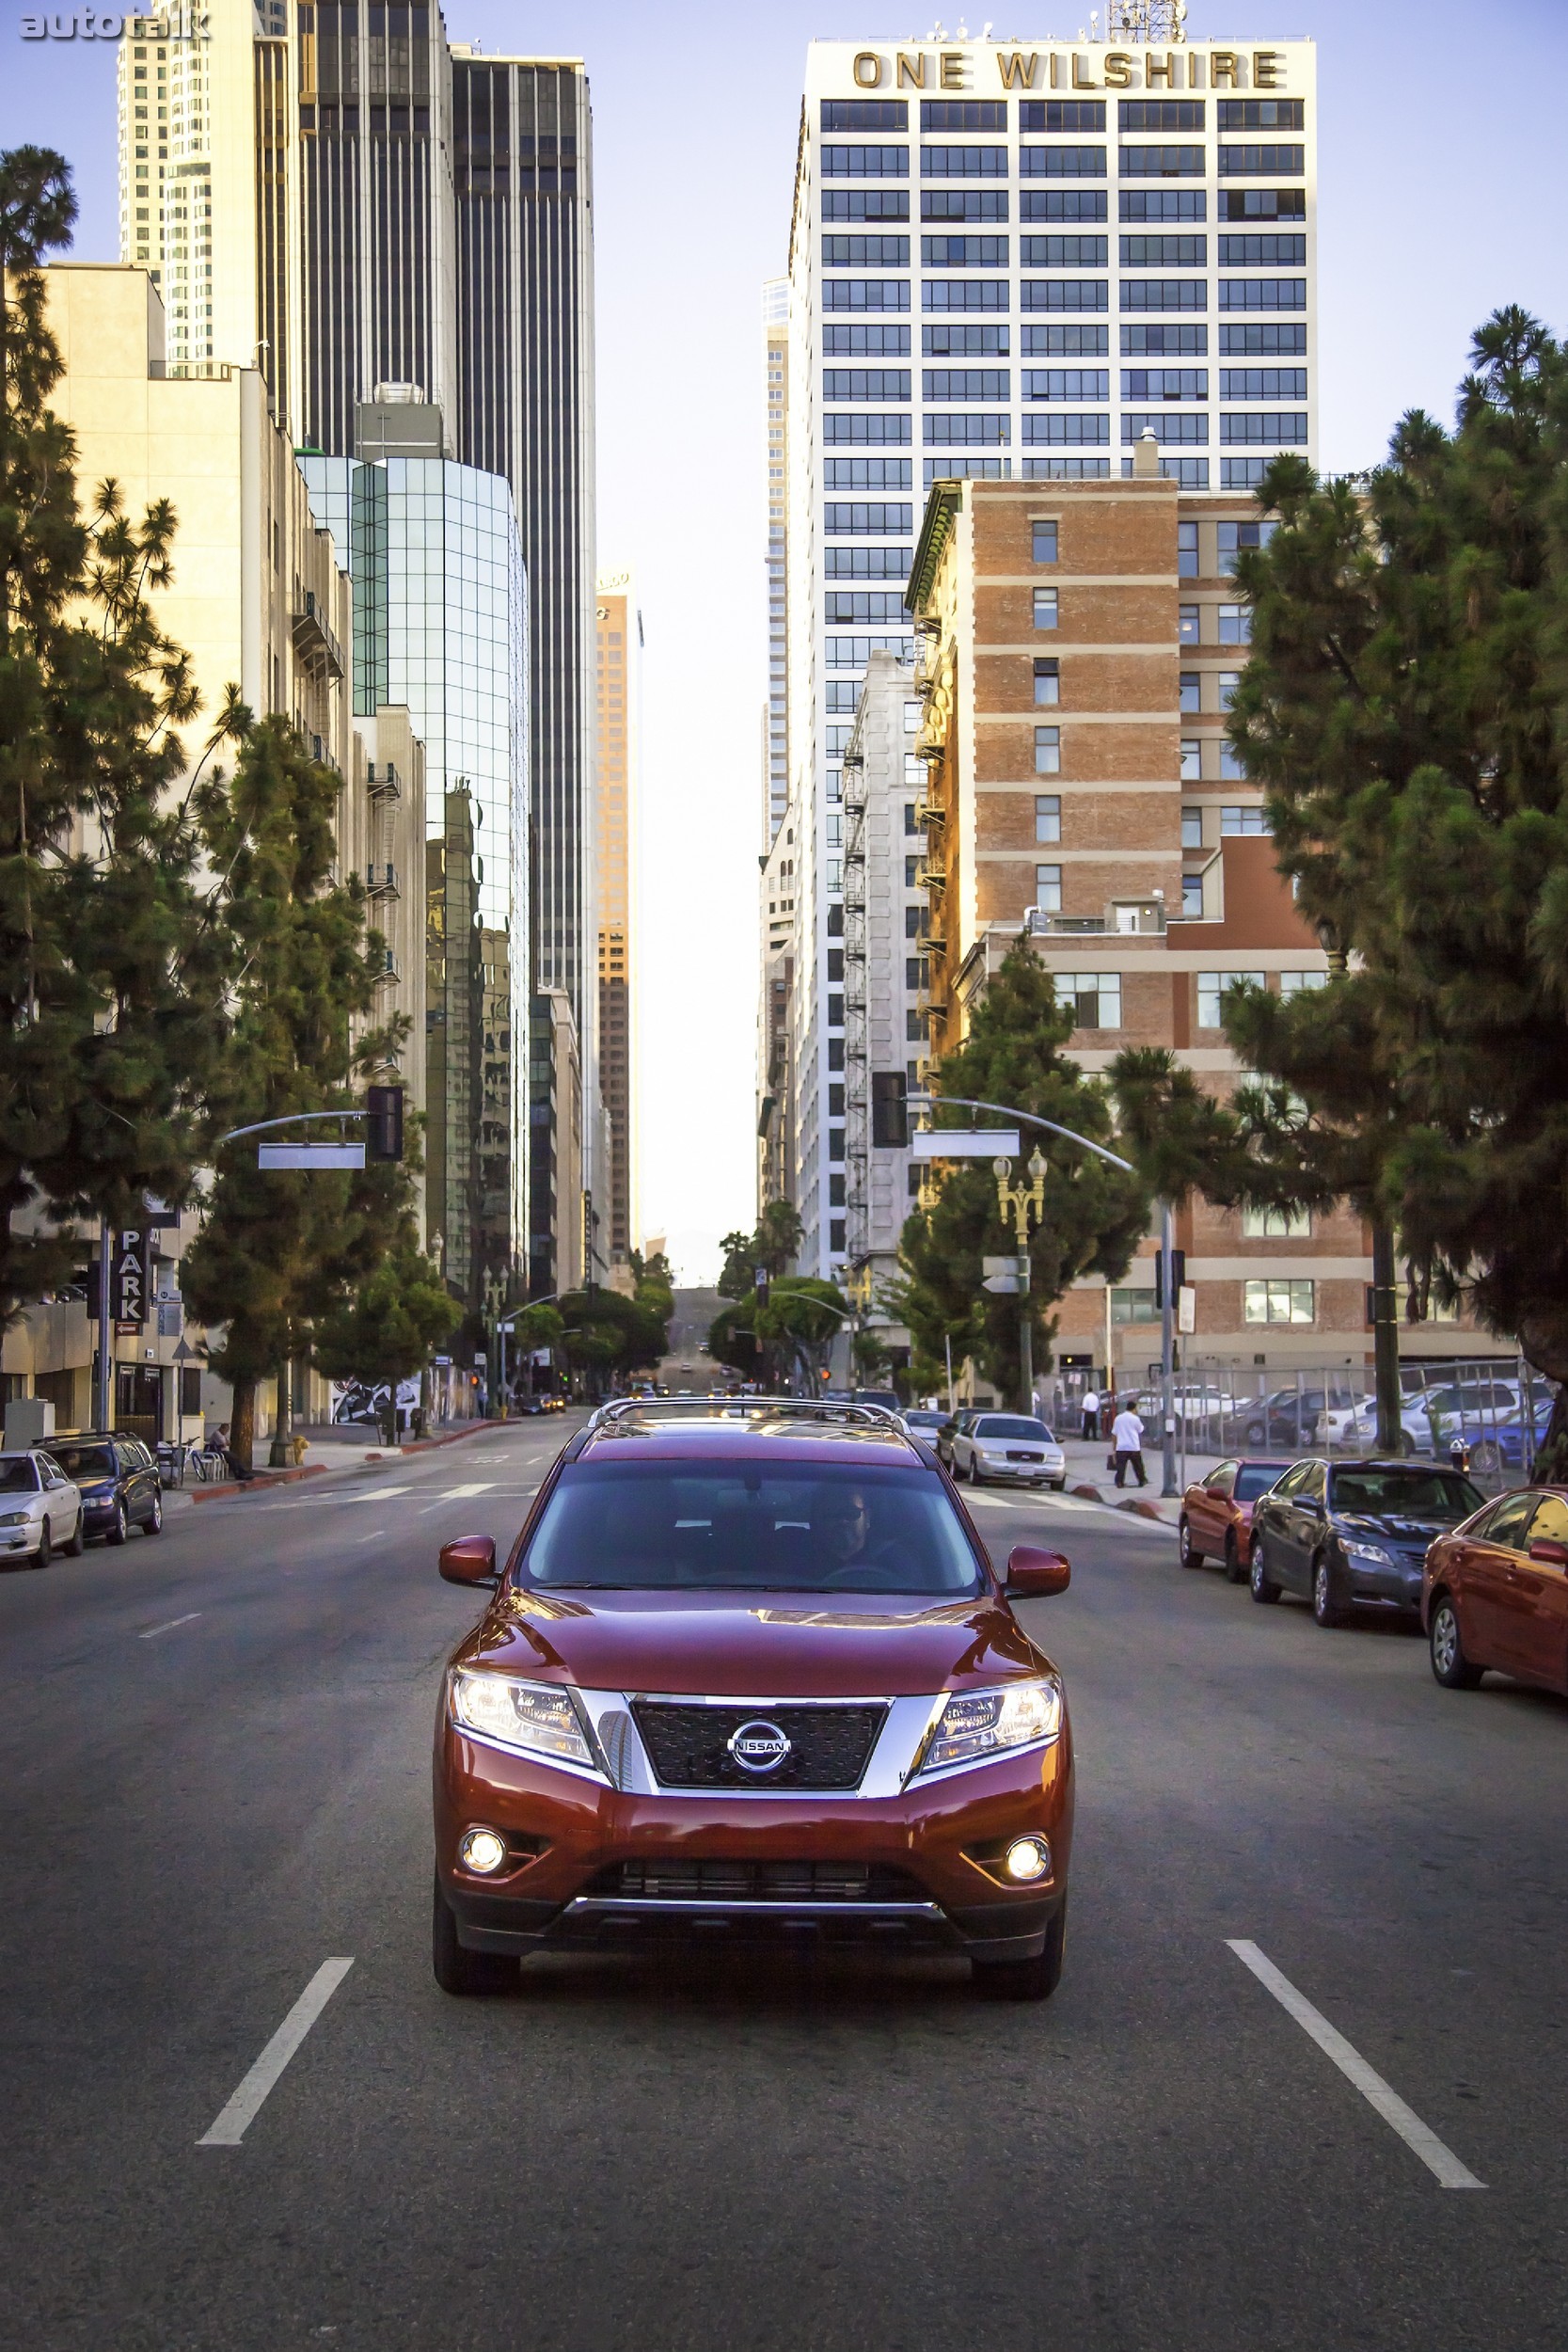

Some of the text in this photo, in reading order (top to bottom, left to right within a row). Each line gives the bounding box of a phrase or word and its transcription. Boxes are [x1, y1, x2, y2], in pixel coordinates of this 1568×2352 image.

[853, 51, 1277, 90] ONE WILSHIRE
[119, 1231, 143, 1319] PARK
[735, 1741, 784, 1751] NISSAN
